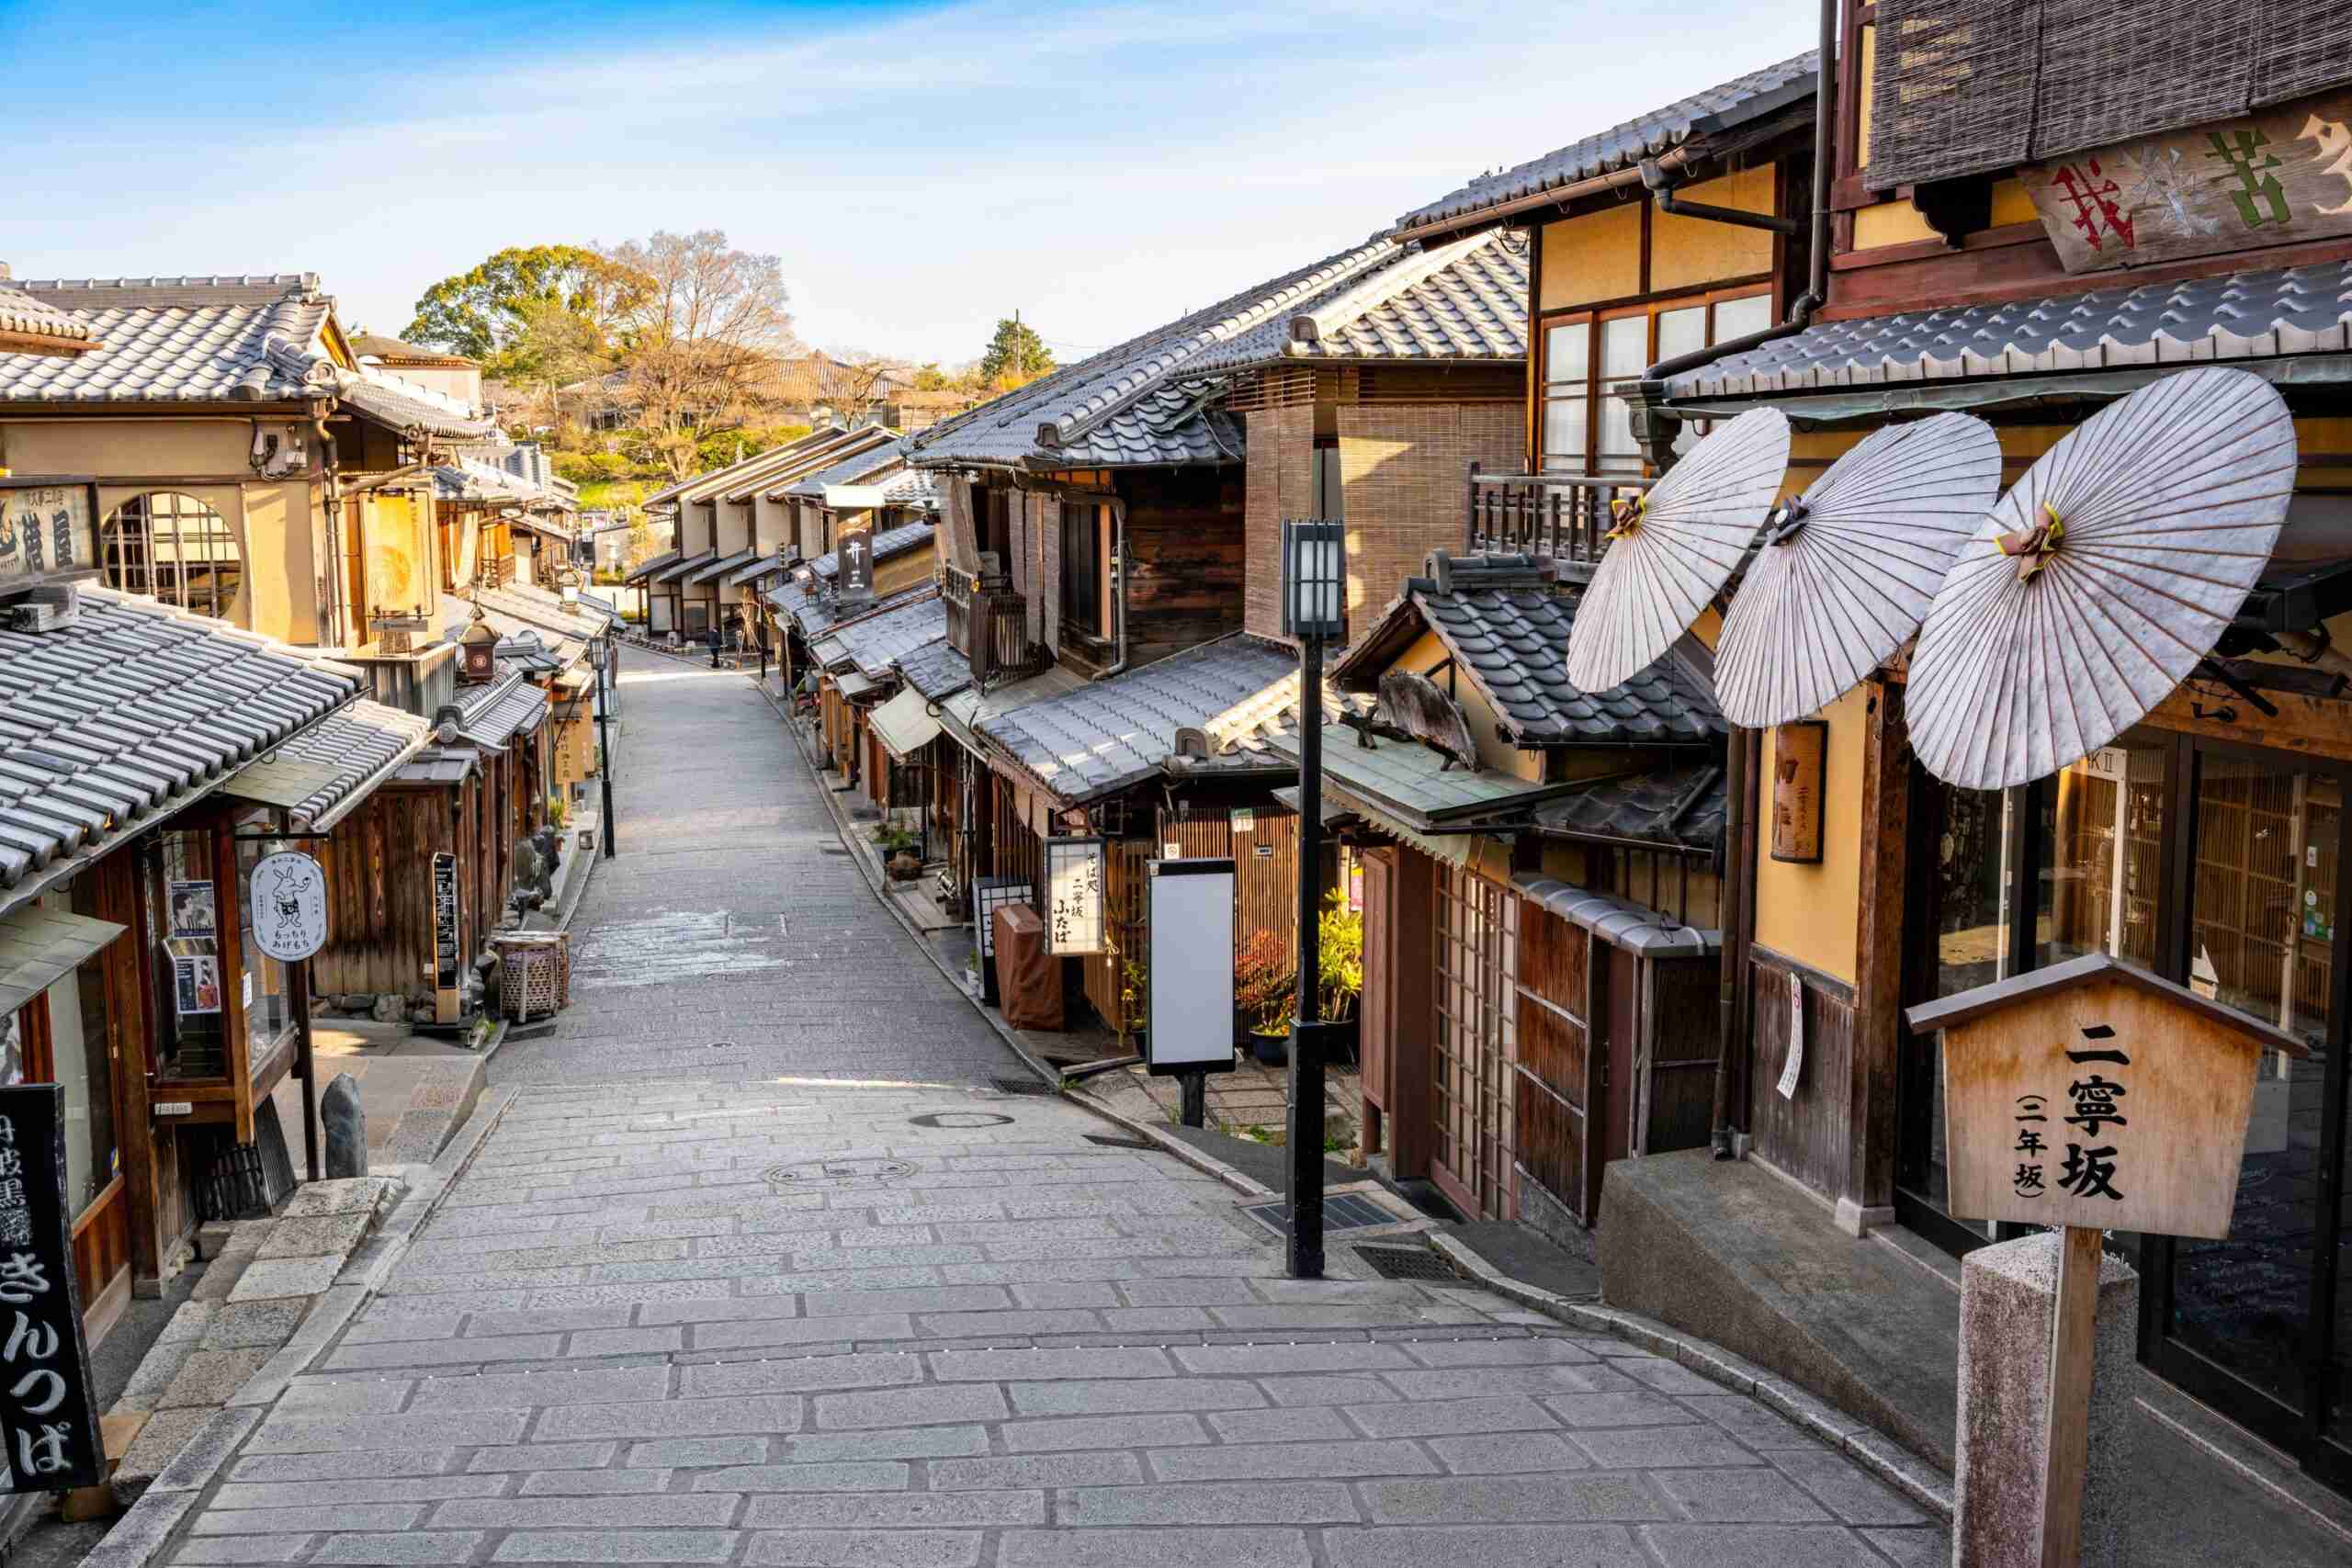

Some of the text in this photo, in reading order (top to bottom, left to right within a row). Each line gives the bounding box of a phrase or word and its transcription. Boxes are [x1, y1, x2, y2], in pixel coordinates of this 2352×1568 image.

[1054, 898, 1071, 944] ふたば
[2057, 1024, 2131, 1201] 二寧坂
